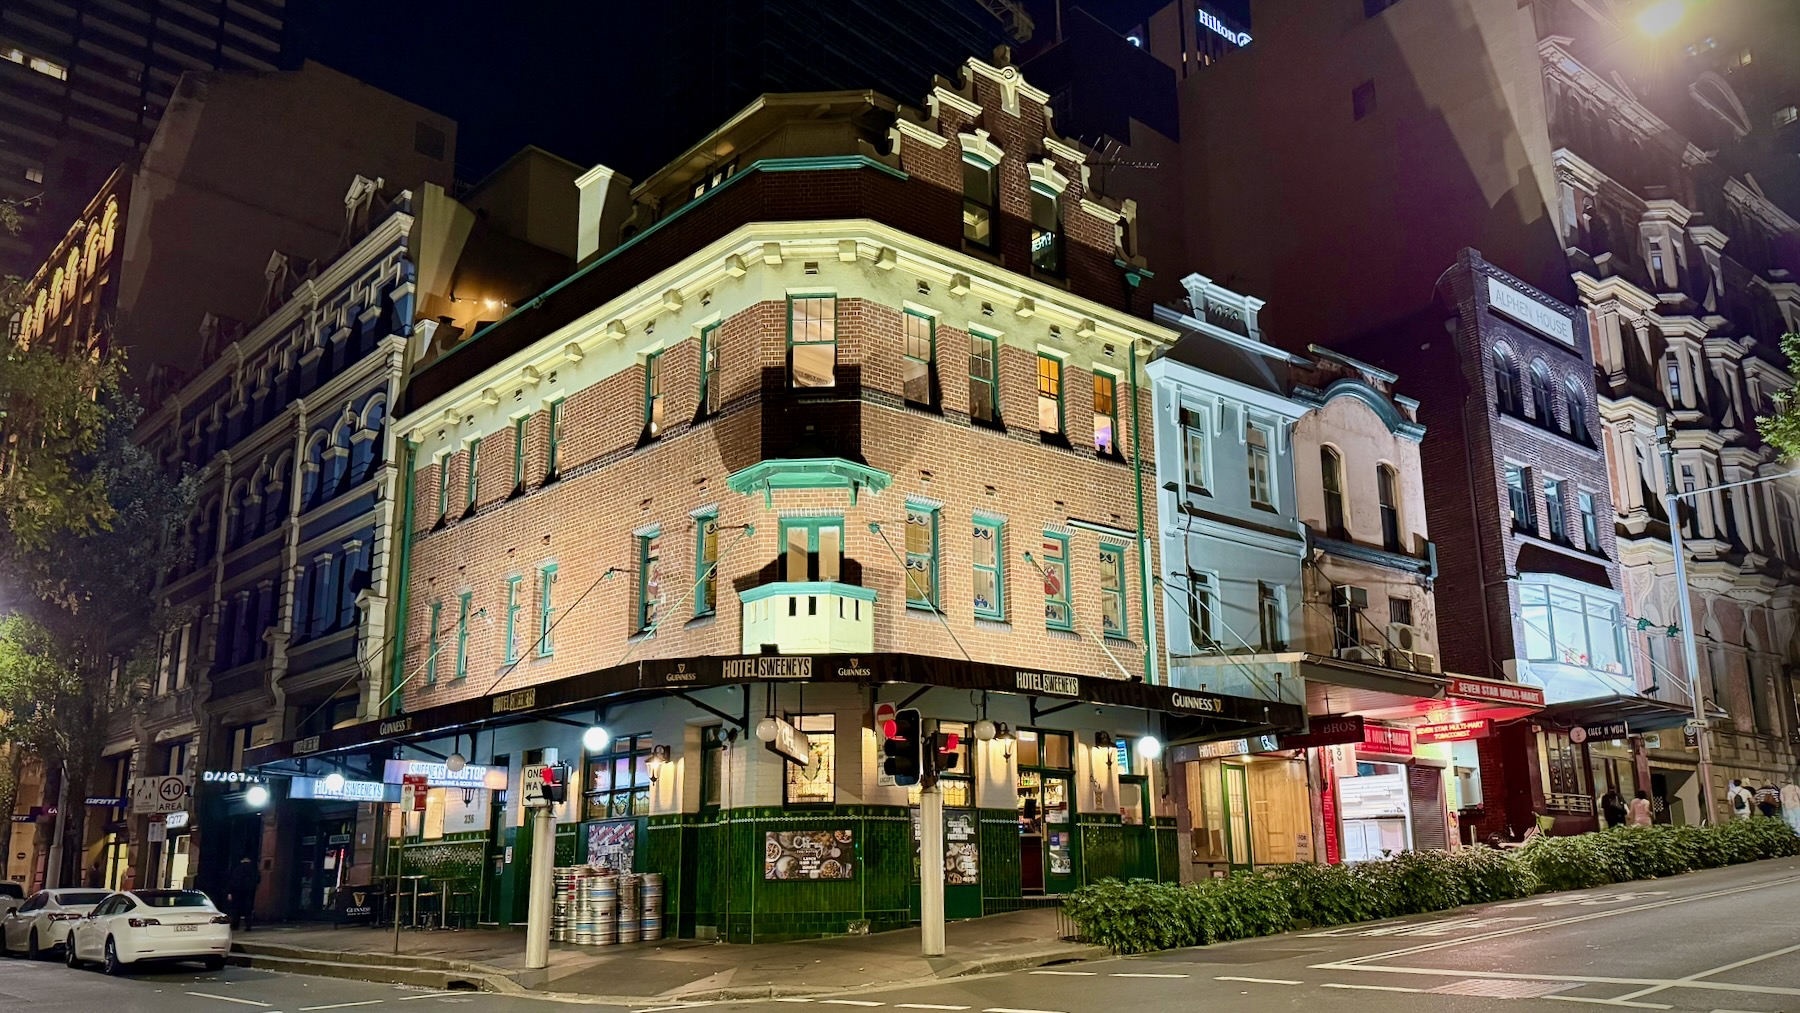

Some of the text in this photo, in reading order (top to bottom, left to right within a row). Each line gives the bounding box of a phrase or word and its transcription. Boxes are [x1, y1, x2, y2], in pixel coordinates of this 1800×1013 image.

[1198, 8, 1238, 45] Hilton
[1495, 289, 1569, 338] ALPHEN HOUSE
[722, 658, 811, 679] HOTEL SWEENEYS
[837, 667, 871, 677] GUINNESS
[666, 672, 697, 682] GUINNESS
[1016, 671, 1043, 691] HOTEL
[1044, 675, 1078, 695] SWEENEYS
[1458, 681, 1539, 703] SEVEN STAR MULTI-MART
[1172, 692, 1213, 712] GUINNESS
[1323, 722, 1357, 734] BROS
[1416, 720, 1484, 735] SEVEN STAR MULTI-MART
[1372, 729, 1409, 747] MULT-MART
[1199, 743, 1217, 758] HOTEL
[527, 769, 544, 778] ONE
[163, 783, 181, 796] 40
[345, 782, 382, 797] SWEENEYS
[159, 802, 183, 811] AREA
